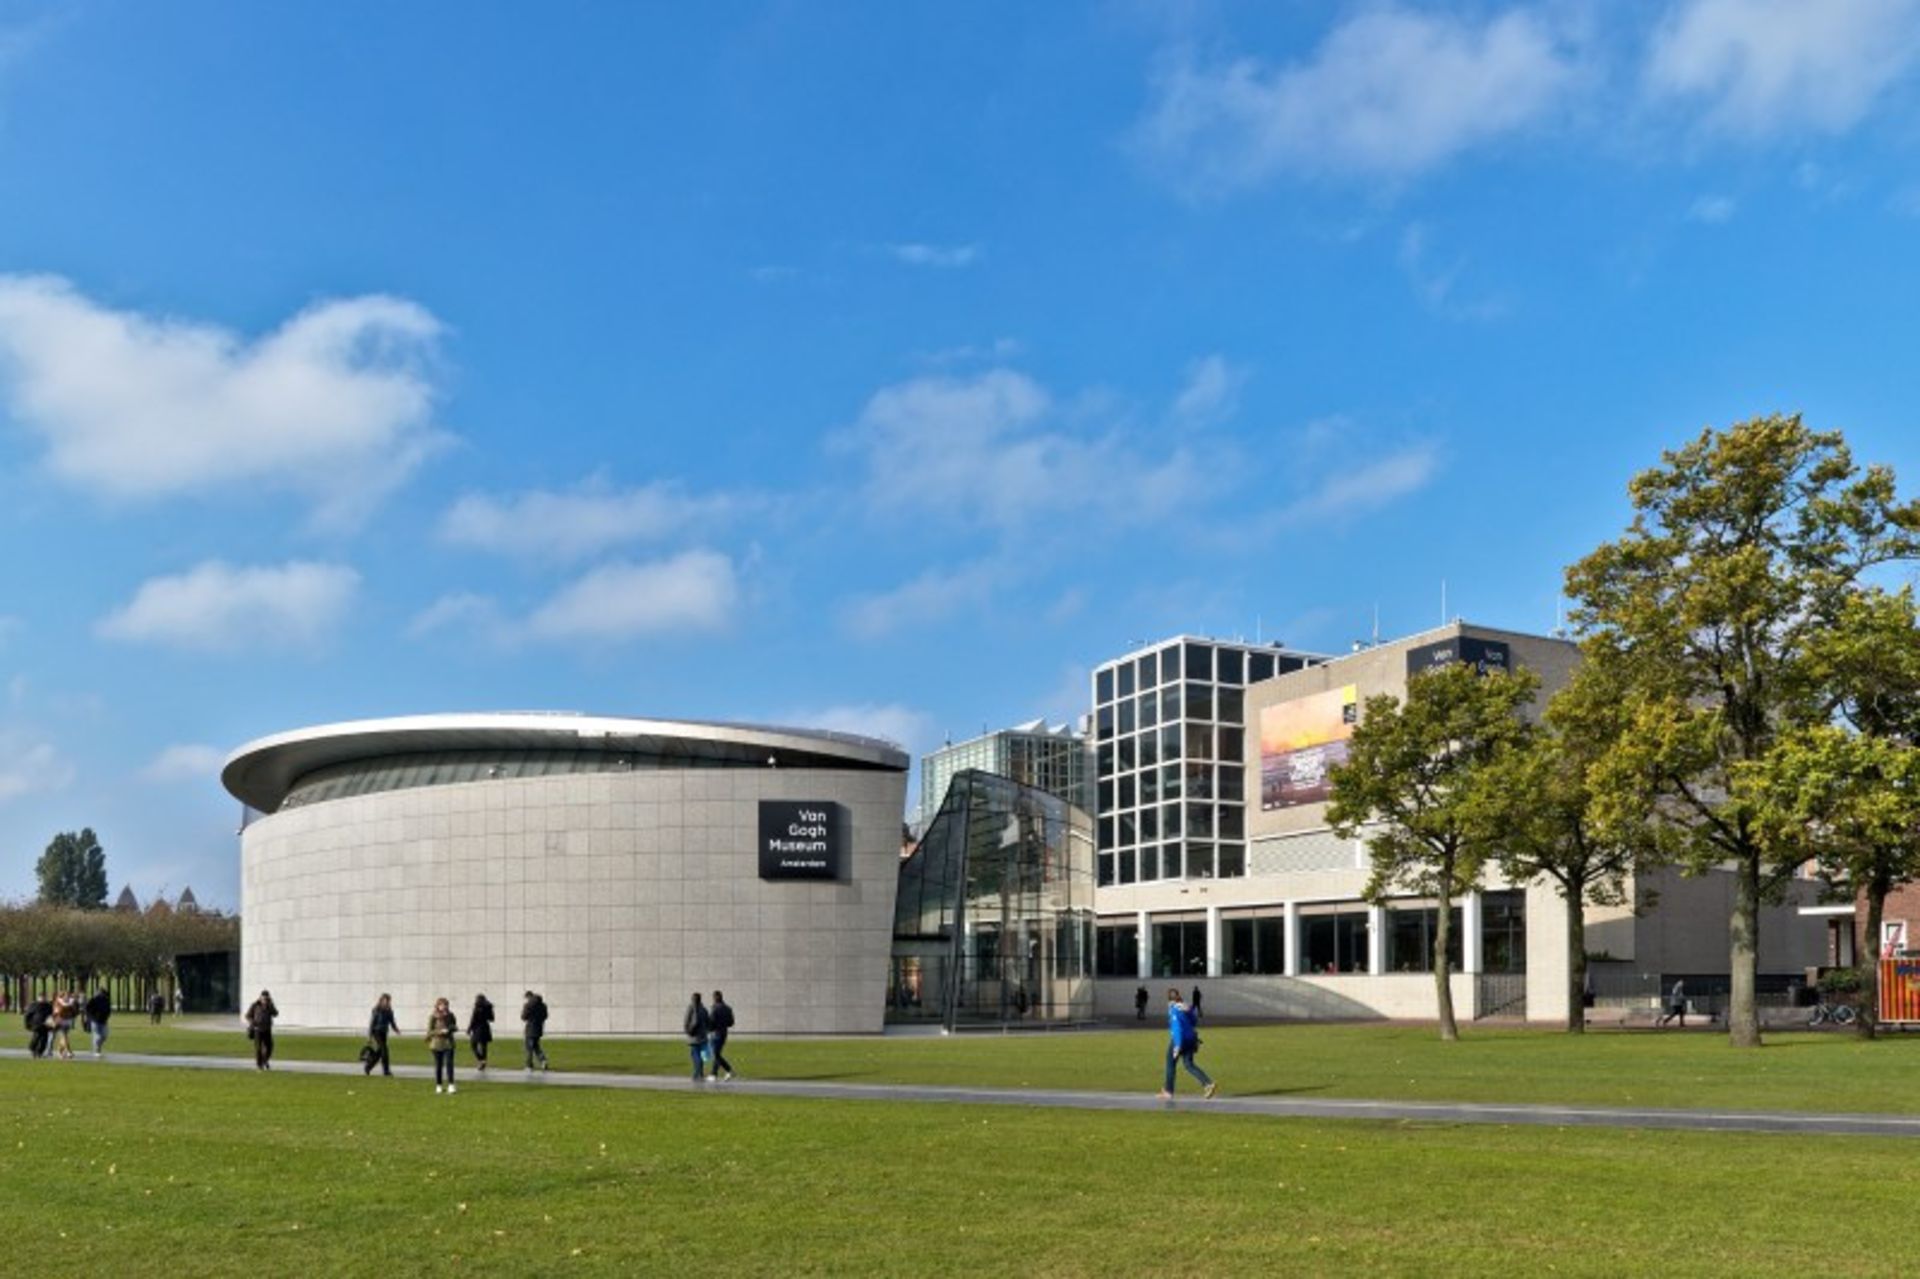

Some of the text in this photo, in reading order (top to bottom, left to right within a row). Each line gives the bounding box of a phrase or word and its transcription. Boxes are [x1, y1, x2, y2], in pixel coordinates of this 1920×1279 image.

[798, 809, 826, 822] Van
[788, 823, 826, 838] Gogh
[769, 839, 827, 851] Museum
[780, 859, 826, 868] Amsterdam
